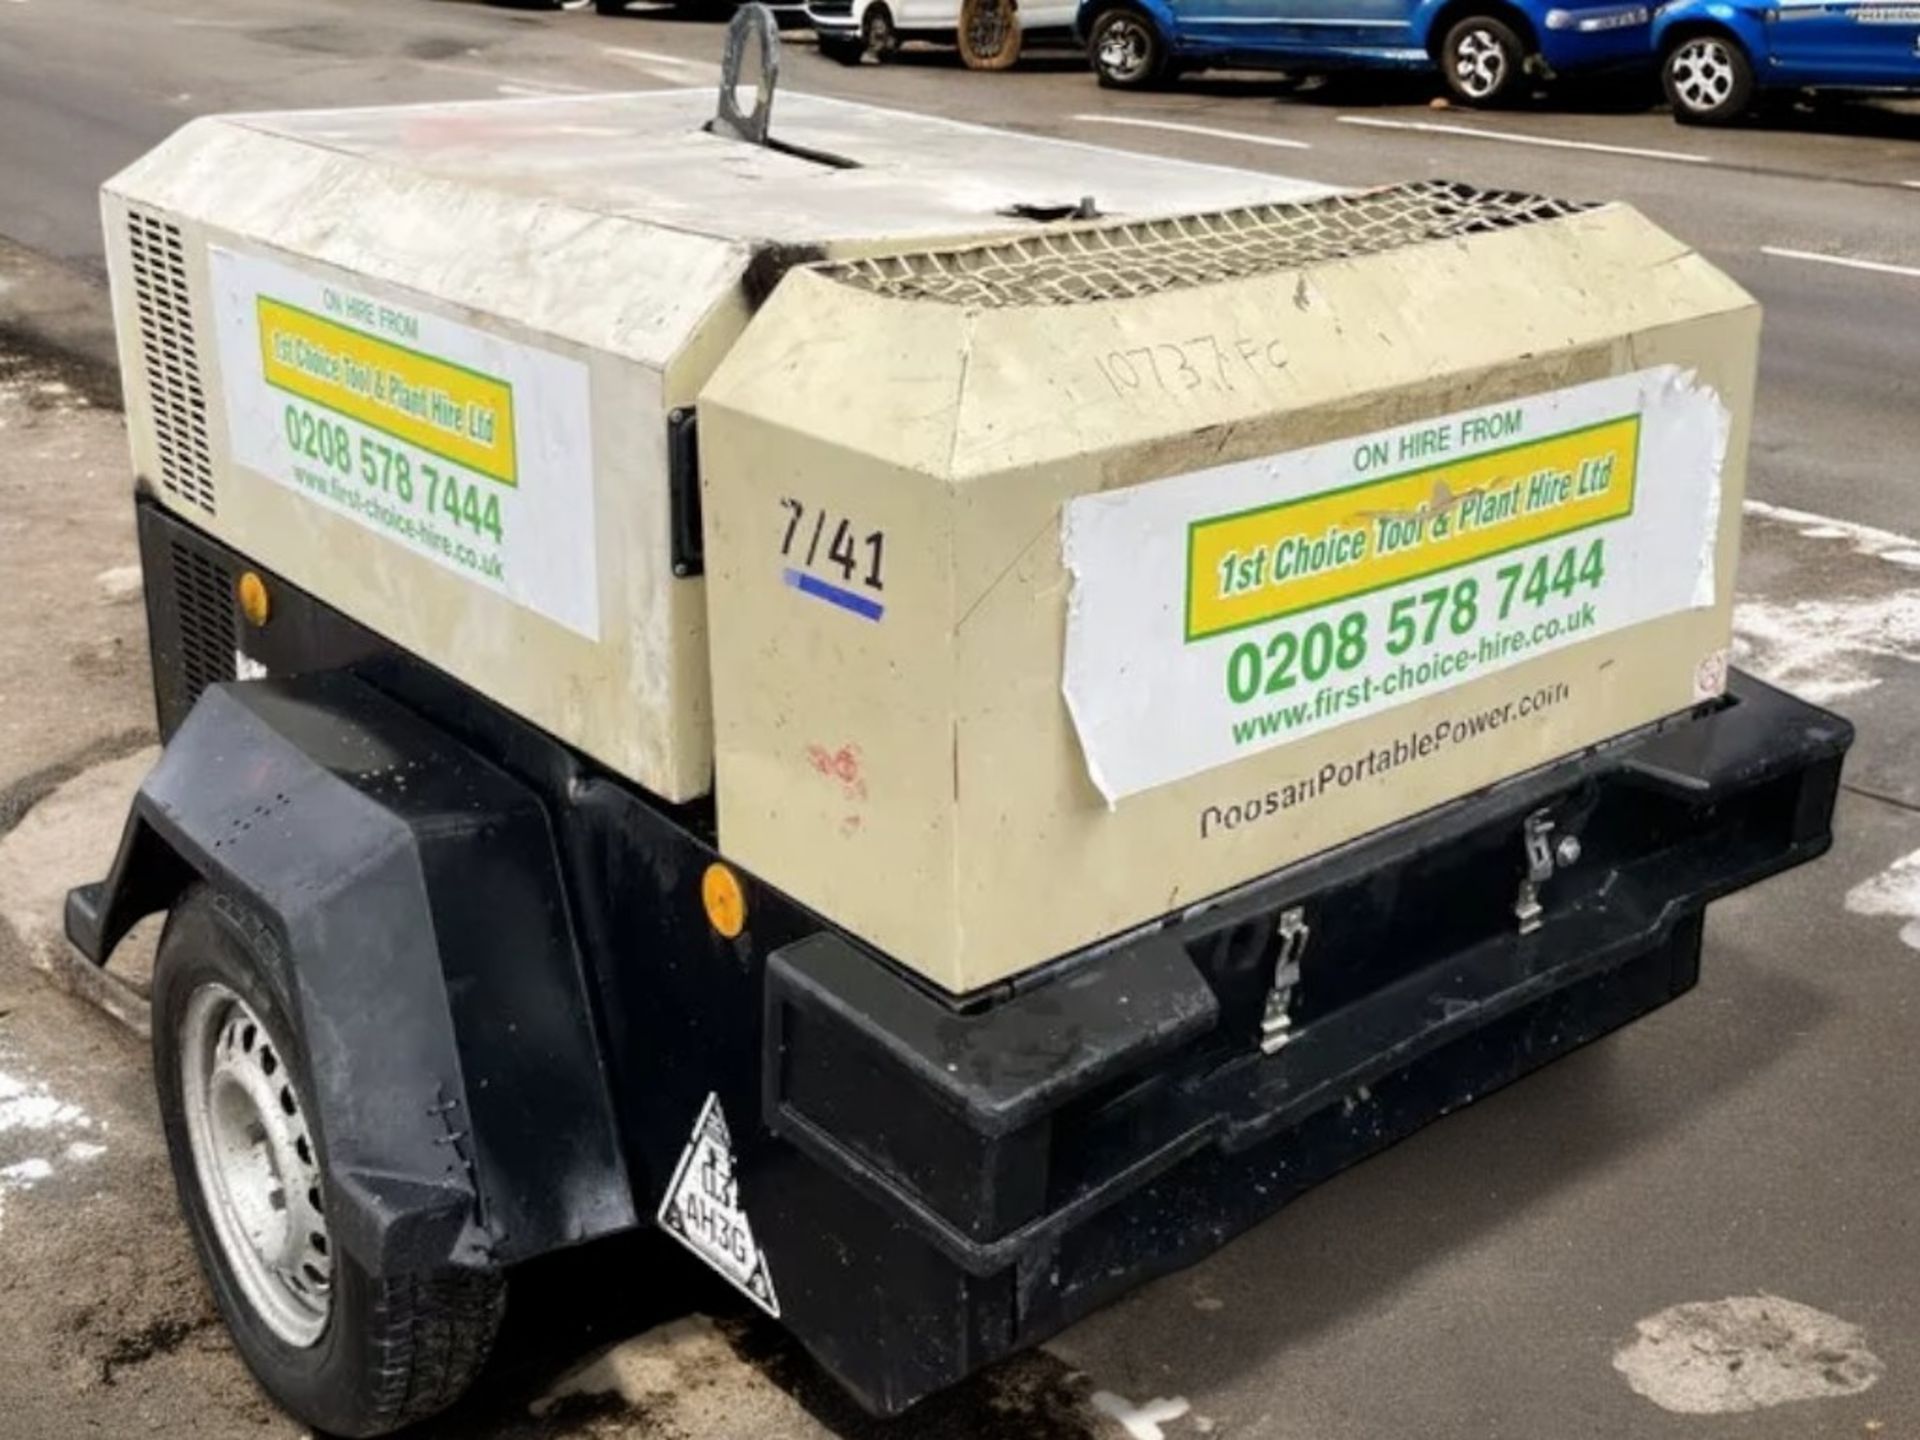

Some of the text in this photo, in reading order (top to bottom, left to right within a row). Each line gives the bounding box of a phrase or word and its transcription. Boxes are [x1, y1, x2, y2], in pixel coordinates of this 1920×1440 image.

[323, 287, 419, 341] ON HIRE FROM
[430, 390, 463, 433] Hire
[1353, 408, 1524, 472] ON HIRE FROM
[285, 403, 504, 544] 0208 578 7444
[1222, 454, 1615, 594] 1st Choice Tool & Plant Hire Ltd
[779, 496, 884, 591] 7/41
[1226, 537, 1605, 705] 0208 578 7444
[1232, 601, 1597, 745] www.first-choice-hire.co.uk
